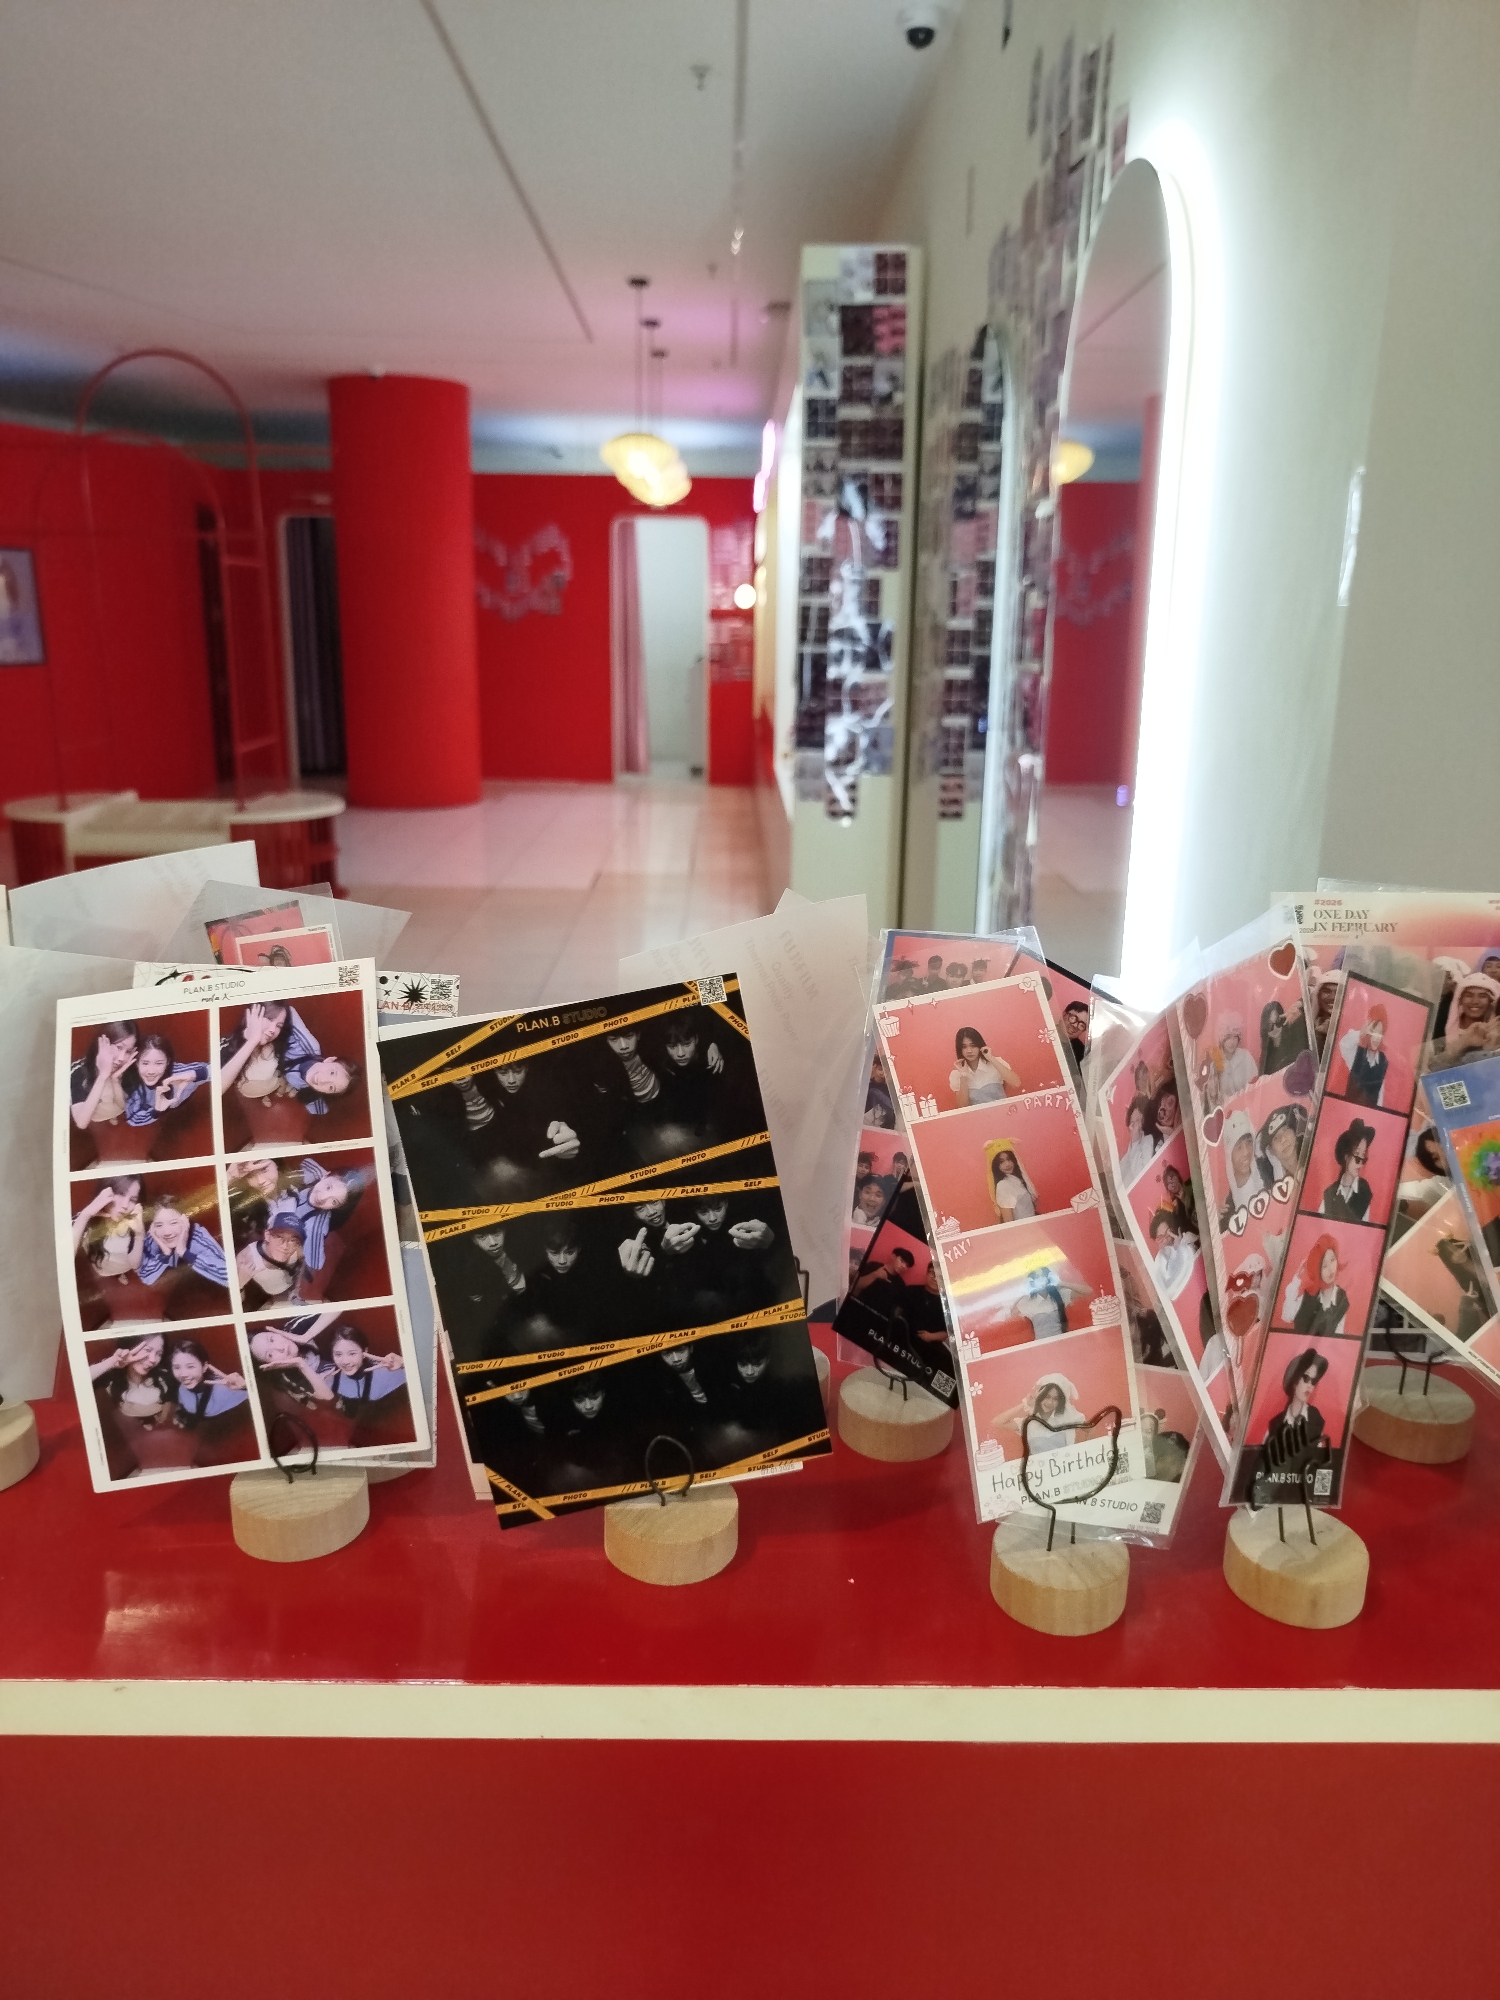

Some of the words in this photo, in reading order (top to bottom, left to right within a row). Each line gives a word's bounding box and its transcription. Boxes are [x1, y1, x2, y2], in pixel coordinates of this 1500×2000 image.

[1313, 909, 1341, 920] ONE
[1345, 909, 1370, 920] DAY
[1313, 922, 1329, 932] IN
[184, 985, 213, 995] PLAN.B
[215, 980, 246, 991] STUDIO
[516, 1015, 560, 1033] PLAN.B
[562, 1006, 608, 1024] STUDIO
[420, 1077, 439, 1089] SELF
[470, 1058, 499, 1072] STUDIO
[551, 1032, 579, 1046] STUDIO
[603, 1016, 629, 1029] PHOTO
[391, 1073, 416, 1092] PLAN.B
[445, 1044, 462, 1059] SELF
[1023, 1093, 1074, 1111] PARTY
[440, 1224, 467, 1236] PLAN.B
[629, 1167, 658, 1180] STUDIO
[681, 1152, 707, 1165] PHOTO
[461, 1208, 490, 1217] STUDIO
[545, 1200, 574, 1209] STUDIO
[599, 1195, 626, 1203] PHOTO
[680, 1186, 709, 1195] PLAN.B
[744, 1180, 762, 1188] SELF
[944, 1238, 972, 1263] YAY!
[537, 1351, 565, 1360] STUDIO
[590, 1343, 616, 1351] PHOTO
[669, 1330, 696, 1340] PLAN.B
[731, 1321, 748, 1329] SELF
[779, 1311, 806, 1320] STUDIO
[510, 1381, 527, 1391] SELF
[558, 1365, 585, 1377] STUDIO
[636, 1342, 664, 1354] STUDIO
[763, 1304, 790, 1316] PLAN.B
[762, 1449, 779, 1459] SELF
[748, 1463, 774, 1472] STUDIO
[505, 1484, 528, 1502] PLAN.B
[562, 1493, 588, 1501] PHOTO
[1099, 1498, 1138, 1512] STUDIO
